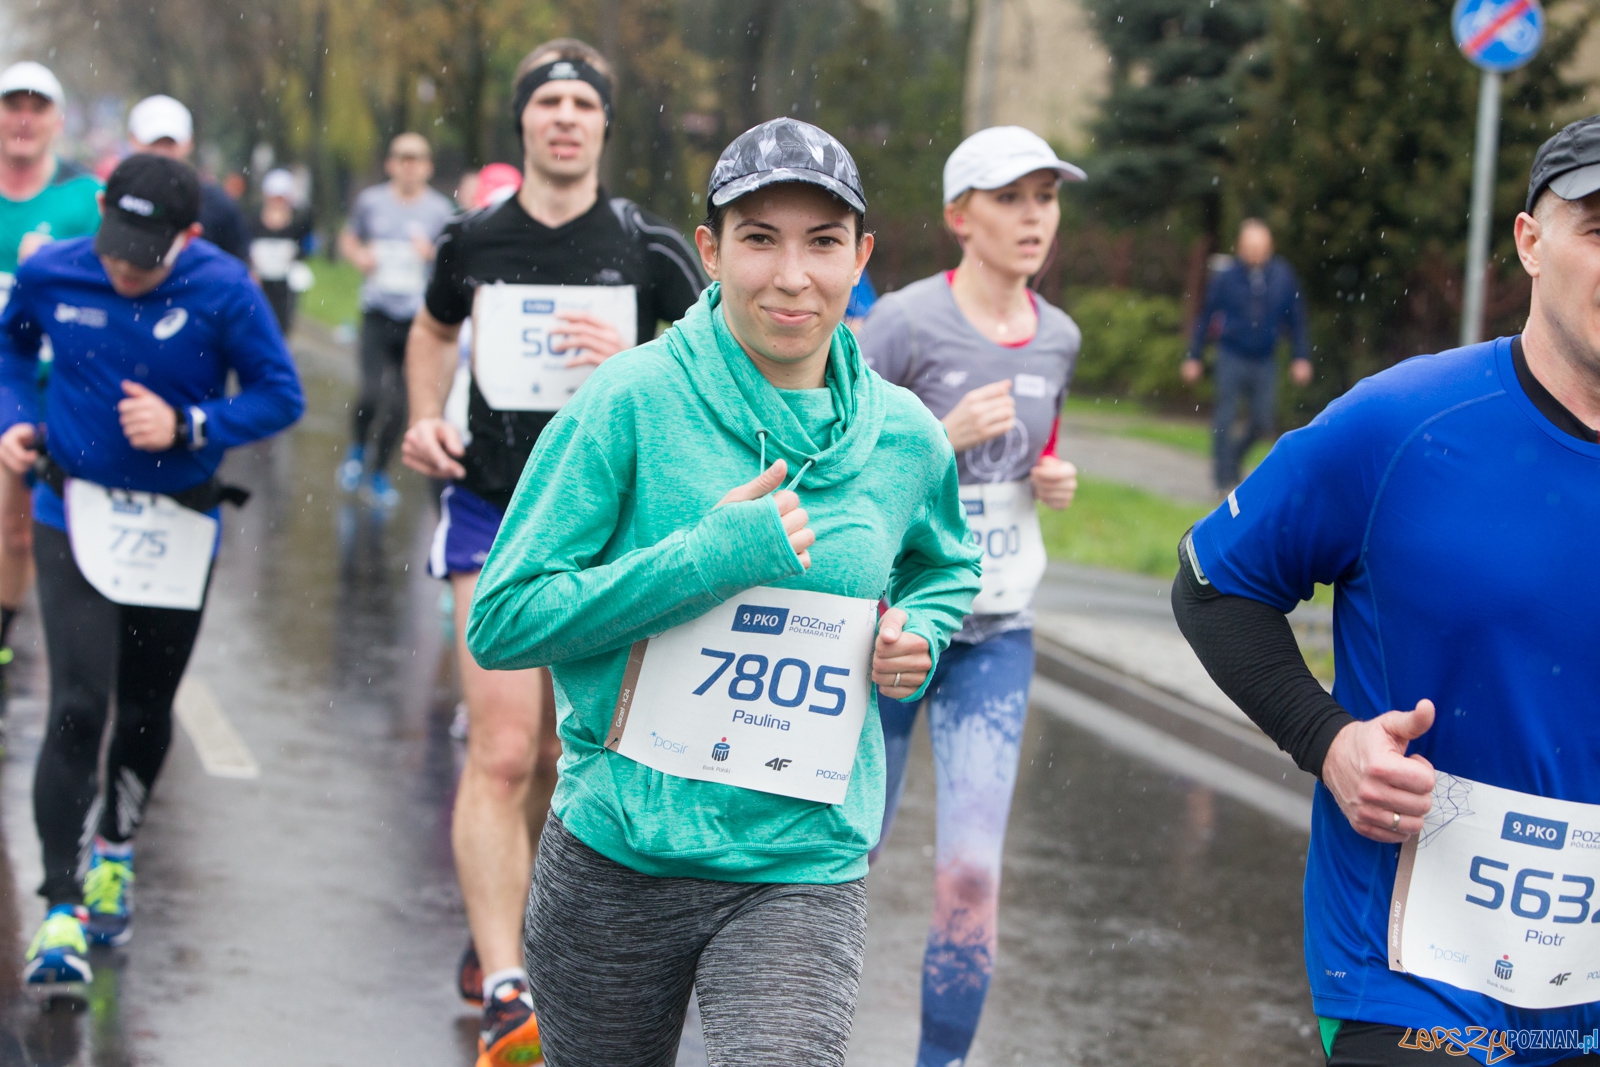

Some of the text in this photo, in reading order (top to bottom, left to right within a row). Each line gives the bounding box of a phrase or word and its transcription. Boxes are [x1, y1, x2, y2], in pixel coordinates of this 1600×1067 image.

[752, 613, 779, 628] PKO
[691, 647, 851, 717] 7805
[732, 709, 791, 731] Paulina
[1525, 823, 1558, 842] PKO
[1525, 929, 1565, 946] Piotr
